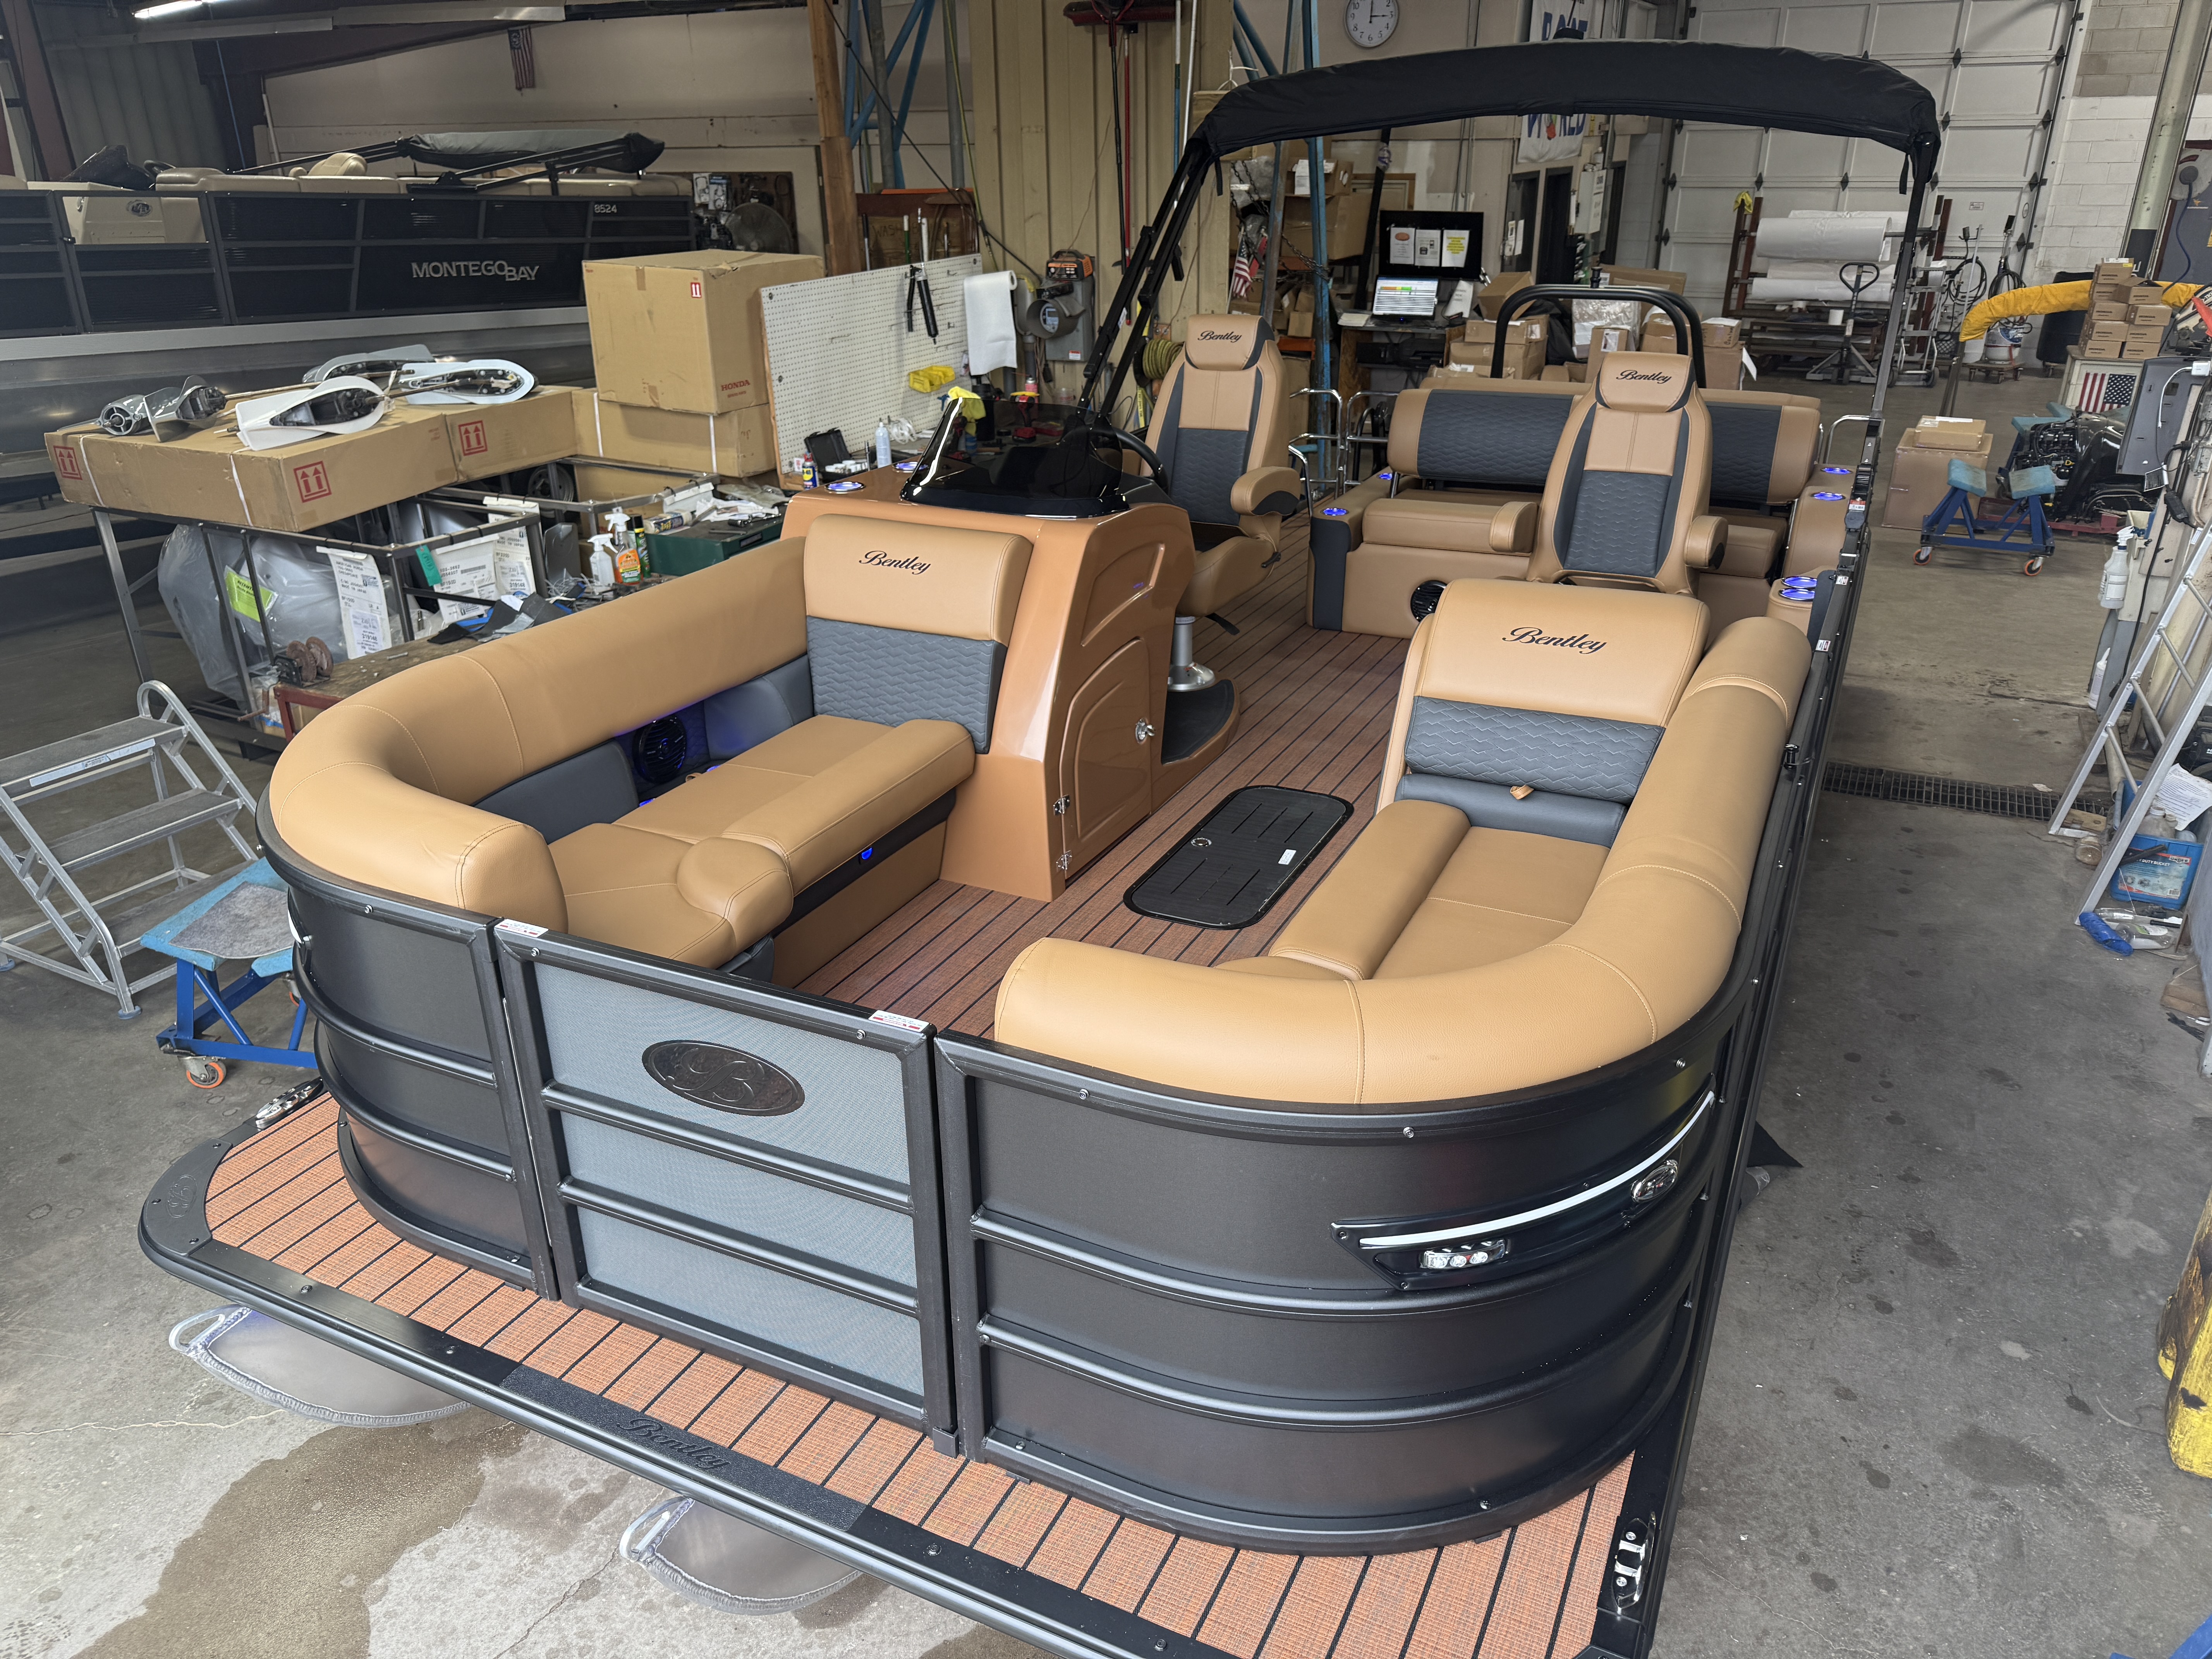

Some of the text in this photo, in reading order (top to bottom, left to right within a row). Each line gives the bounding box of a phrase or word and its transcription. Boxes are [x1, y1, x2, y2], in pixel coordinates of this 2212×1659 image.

[1197, 330, 1243, 343] Bentley
[721, 380, 750, 391] HONDA
[1616, 369, 1672, 384] Bentley
[859, 550, 932, 575] Bentley
[1502, 626, 1607, 654] Bentley
[616, 1417, 731, 1471] Bentley
